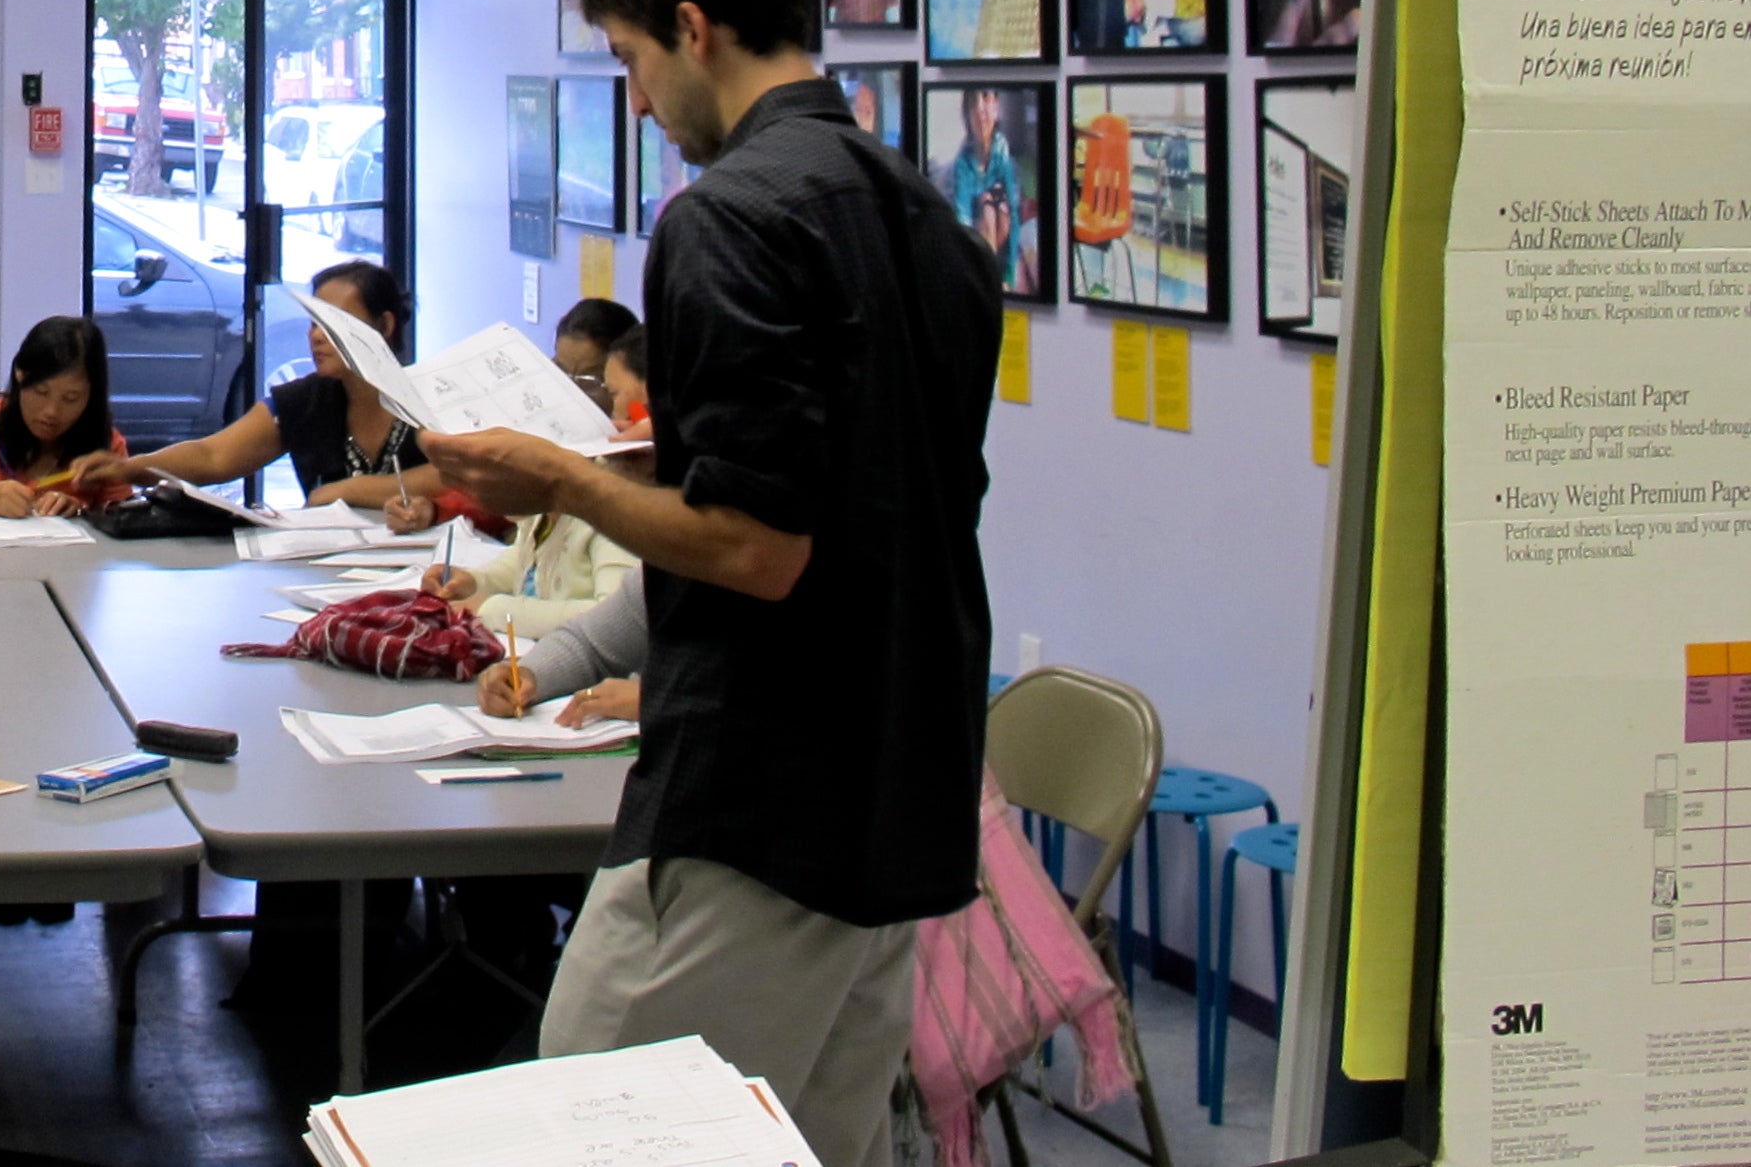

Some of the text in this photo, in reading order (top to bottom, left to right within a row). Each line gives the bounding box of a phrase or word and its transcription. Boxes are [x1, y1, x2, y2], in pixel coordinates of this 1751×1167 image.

[1520, 11, 1560, 40] Una
[1566, 12, 1628, 40] buena
[1633, 13, 1675, 39] idea
[1679, 19, 1726, 47] para
[1520, 48, 1693, 86] próxima reunión!
[35, 114, 60, 130] FIRE
[1509, 200, 1592, 223] Self-Stick
[1597, 200, 1648, 222] Sheets
[1654, 200, 1708, 221] Attach
[1713, 200, 1734, 221] To
[1508, 226, 1686, 252] And Remove Cleanly
[1505, 259, 1552, 280] Unique
[1555, 259, 1611, 276] adhesive
[1614, 258, 1651, 275] sticks
[1654, 260, 1667, 274] to
[1670, 260, 1701, 274] most
[1707, 279, 1744, 296] fabric
[1505, 308, 1522, 326] up
[1525, 307, 1538, 321] to
[1604, 303, 1673, 323] Reposition
[1676, 306, 1691, 319] or
[1693, 305, 1740, 319] remove
[1505, 384, 1691, 412] Bleed Resistant Paper
[1504, 422, 1585, 444] High-quality
[1589, 423, 1624, 442] paper
[1505, 447, 1532, 462] next
[1535, 448, 1566, 466] page
[1569, 443, 1592, 460] and
[1596, 441, 1623, 458] wall
[1505, 487, 1559, 513] Heavy
[1565, 484, 1625, 512] Weight
[1629, 482, 1706, 505] Premium
[1504, 521, 1570, 540] Perforated
[1573, 520, 1612, 537] sheets
[1615, 519, 1645, 540] keep
[1648, 522, 1672, 539] you
[1675, 517, 1698, 533] and
[1701, 520, 1730, 538] your
[1505, 545, 1553, 565] looking
[1491, 1003, 1544, 1036] 3M
